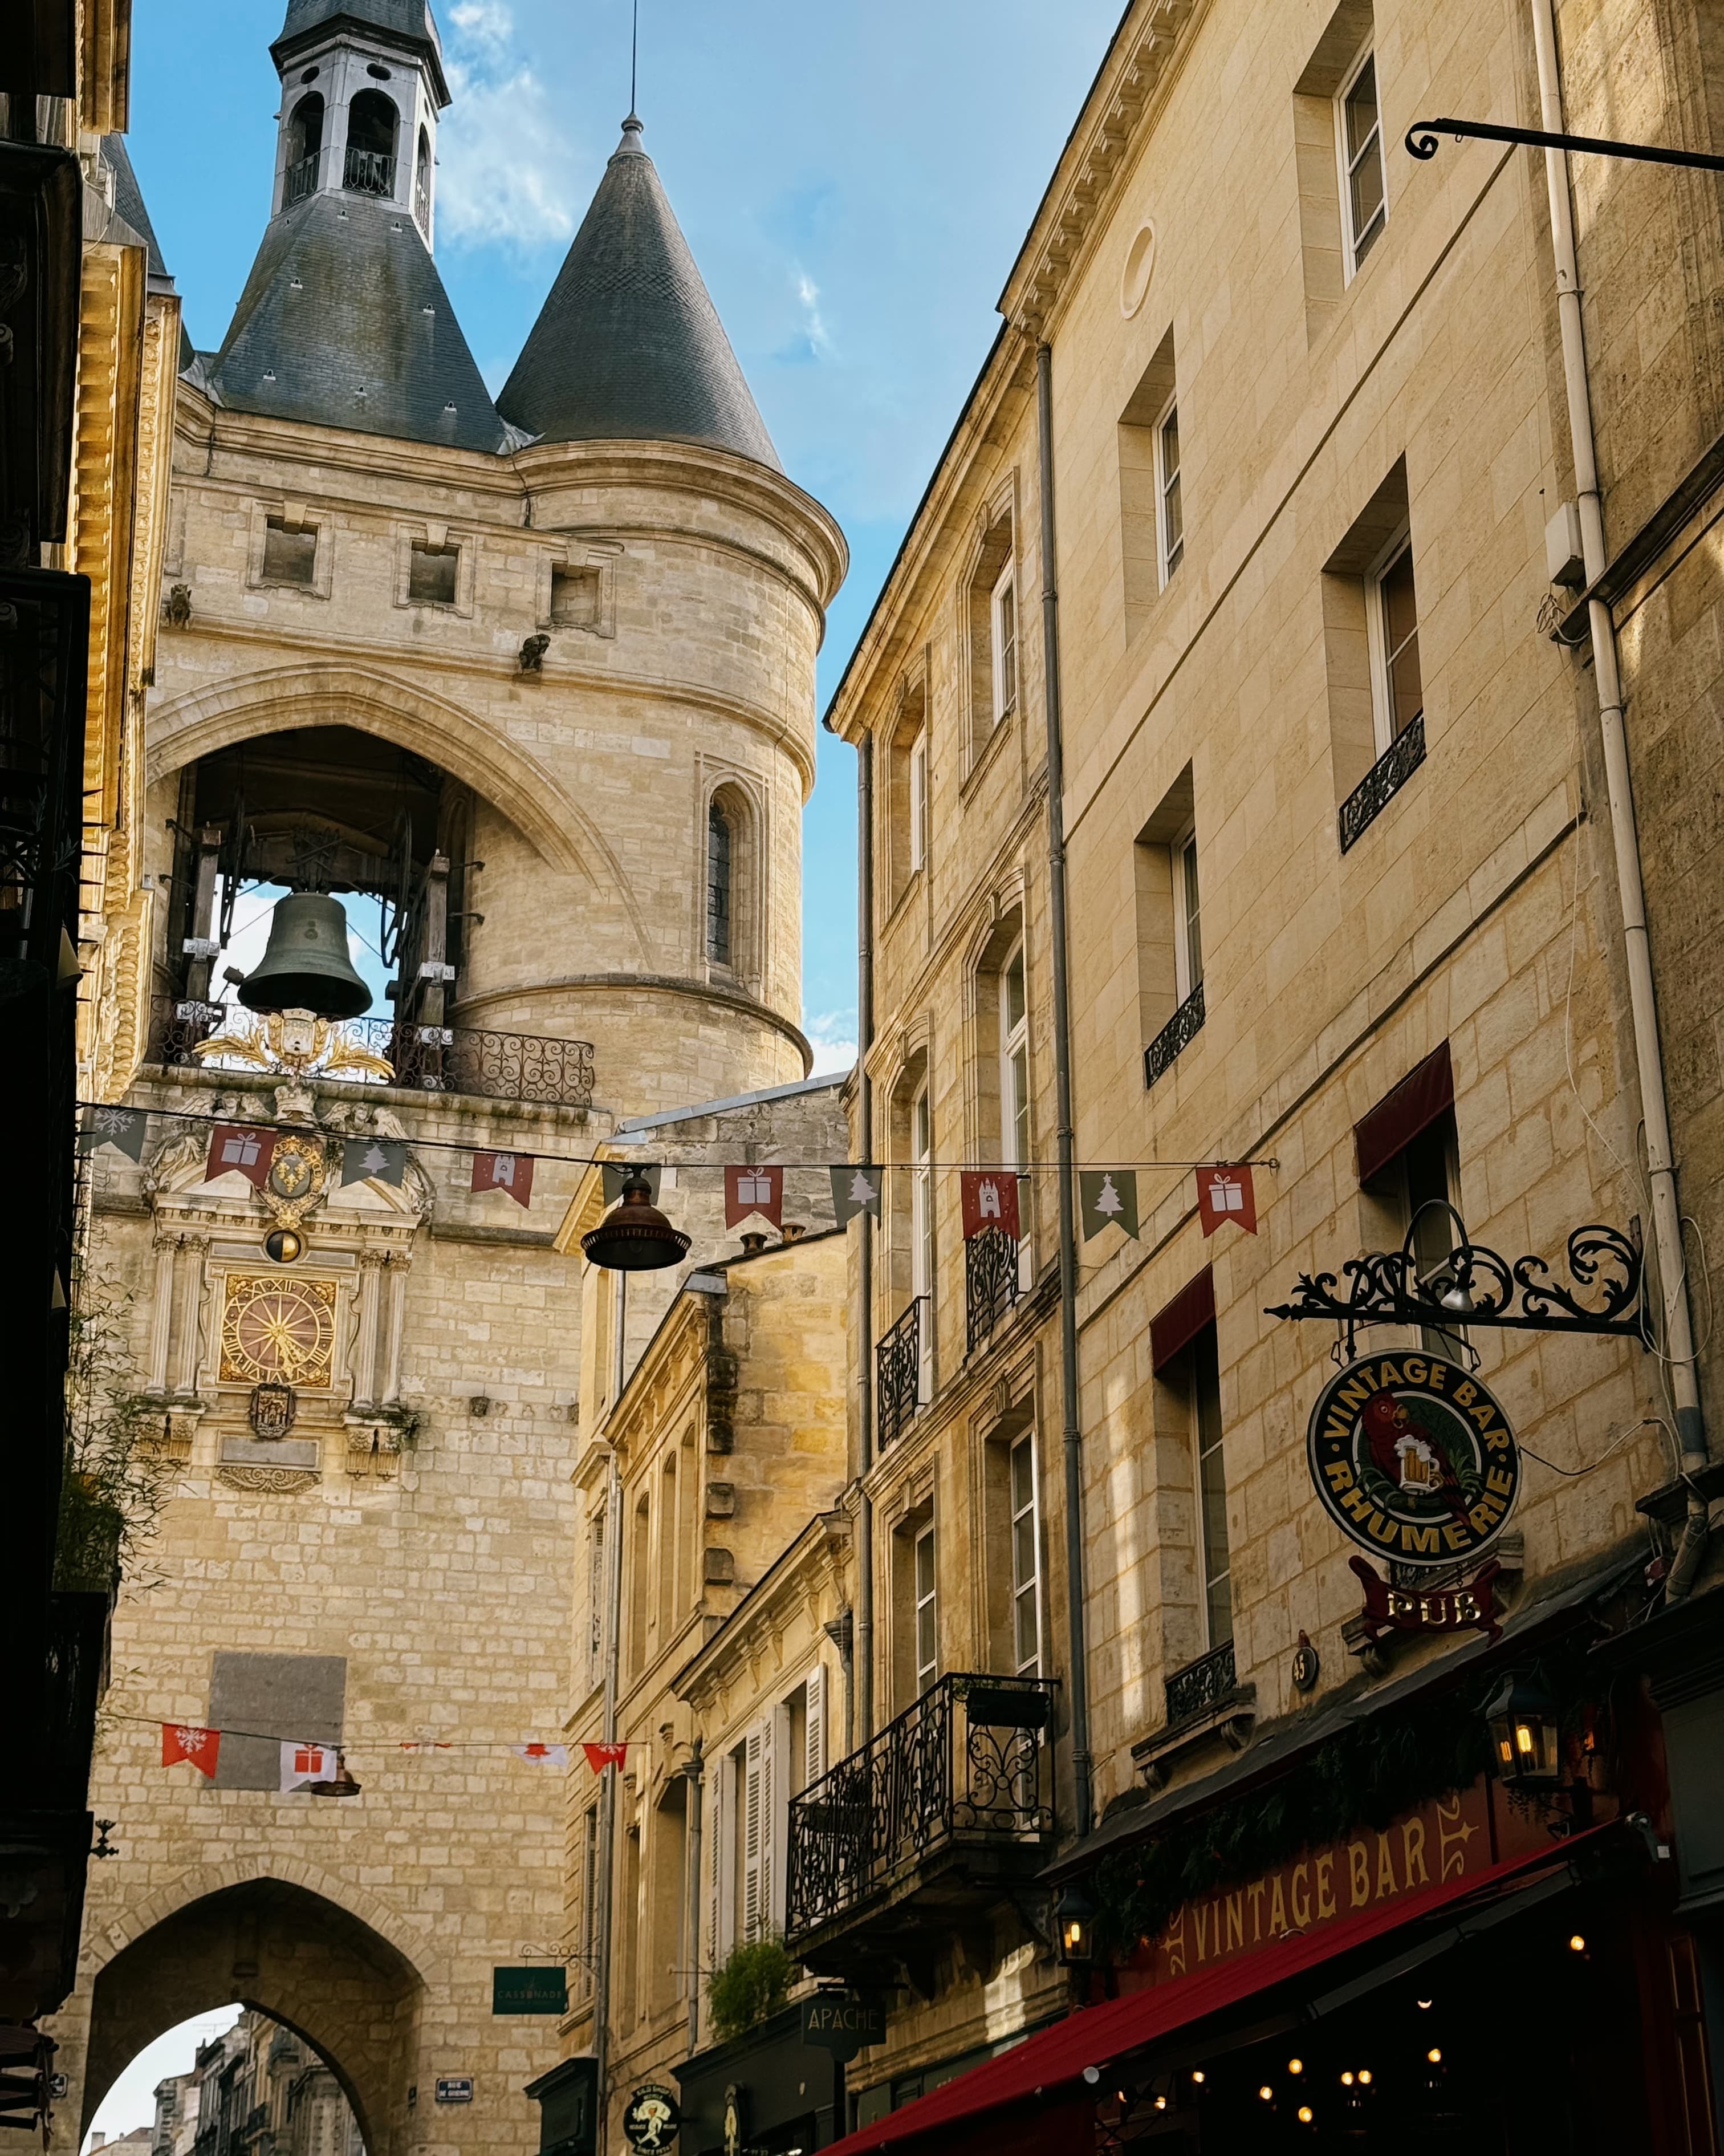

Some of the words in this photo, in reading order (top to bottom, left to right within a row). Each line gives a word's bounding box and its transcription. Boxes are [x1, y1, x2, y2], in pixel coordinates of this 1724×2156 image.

[270, 1280, 292, 1292] XII
[319, 1328, 334, 1339] III
[1323, 1358, 1447, 1438] VINTAGE
[1453, 1379, 1510, 1452] BAR
[1324, 1459, 1514, 1553] RHUMERIE
[1387, 1590, 1481, 1625] PUB
[1293, 1654, 1305, 1681] 45
[1193, 1851, 1336, 1962] VINTAGE
[1348, 1816, 1430, 1908] BAR
[808, 2008, 879, 2030] APACHE
